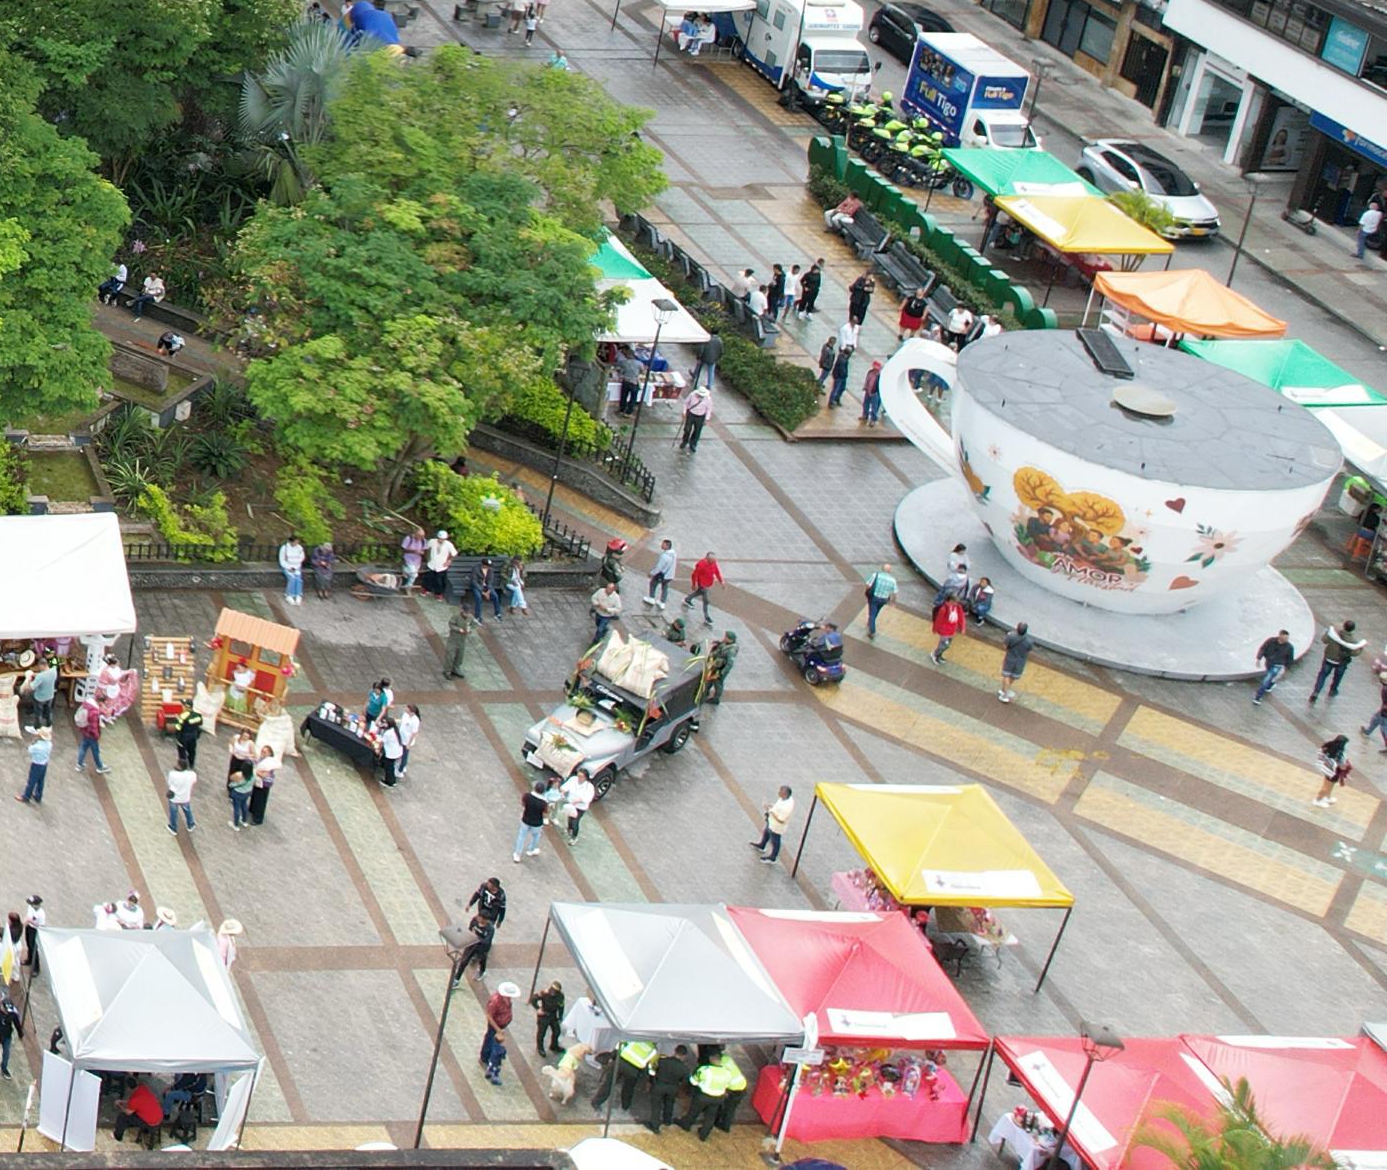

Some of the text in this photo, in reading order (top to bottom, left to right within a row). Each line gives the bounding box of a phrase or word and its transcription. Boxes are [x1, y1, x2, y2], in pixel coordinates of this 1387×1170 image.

[919, 80, 938, 103] Full
[936, 91, 958, 117] Tigo
[1051, 556, 1123, 584] AMOR
